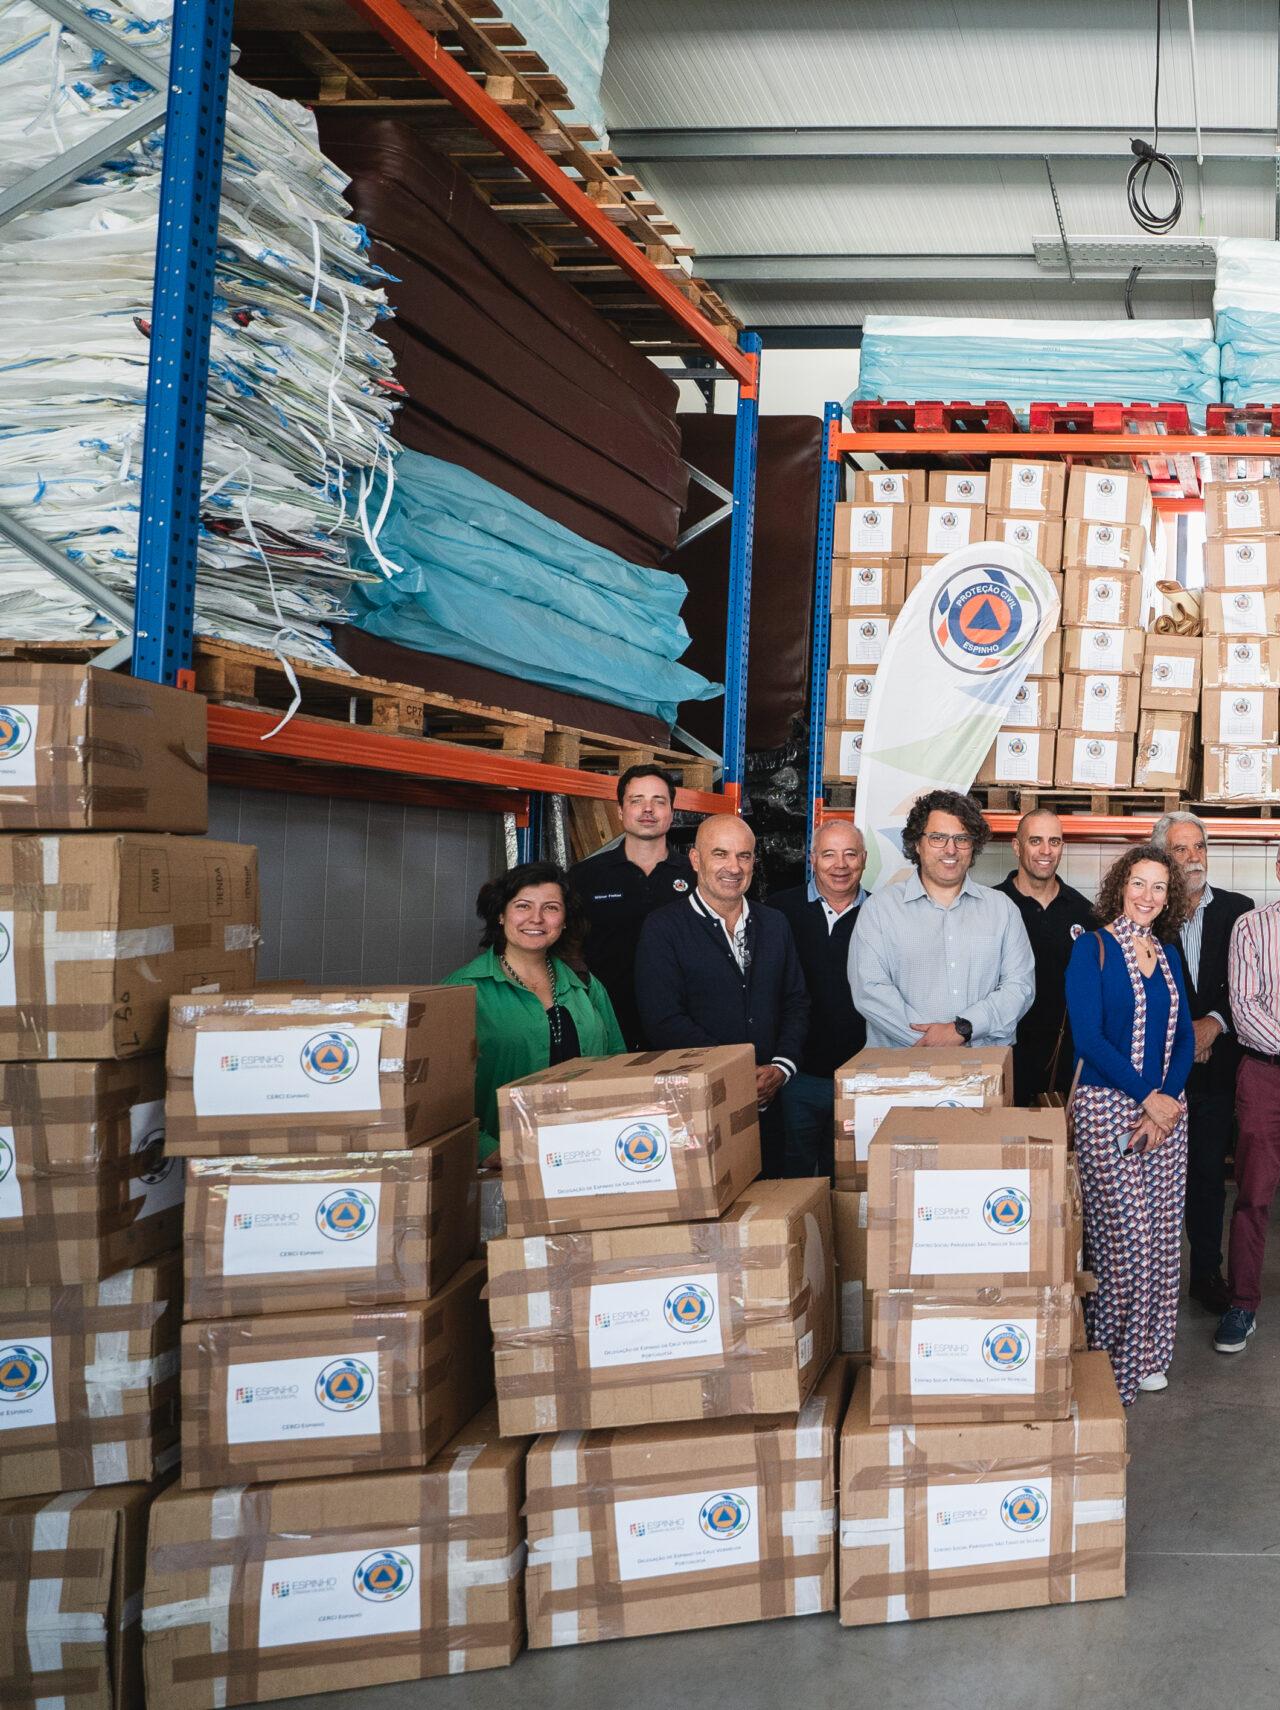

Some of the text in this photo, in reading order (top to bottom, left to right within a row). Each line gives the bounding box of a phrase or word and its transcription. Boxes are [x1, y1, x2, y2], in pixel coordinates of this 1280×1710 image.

[956, 585, 1018, 610] PROTEÇÃO CIVIL
[962, 642, 999, 654] ESPINHO
[151, 868, 160, 894] AWB
[241, 1054, 285, 1065] ESPINHO
[564, 1148, 602, 1160] ESPINHO
[934, 1207, 970, 1216] ESPINHO
[254, 1213, 300, 1223] ESPINHO
[612, 1309, 650, 1321] ESPINHO
[933, 1343, 969, 1352] ESPINHO
[255, 1385, 299, 1396] ESPINHO
[952, 1508, 988, 1519] ESPINHO
[647, 1518, 685, 1530] ESPINHO
[292, 1577, 337, 1590] ESPINHO
